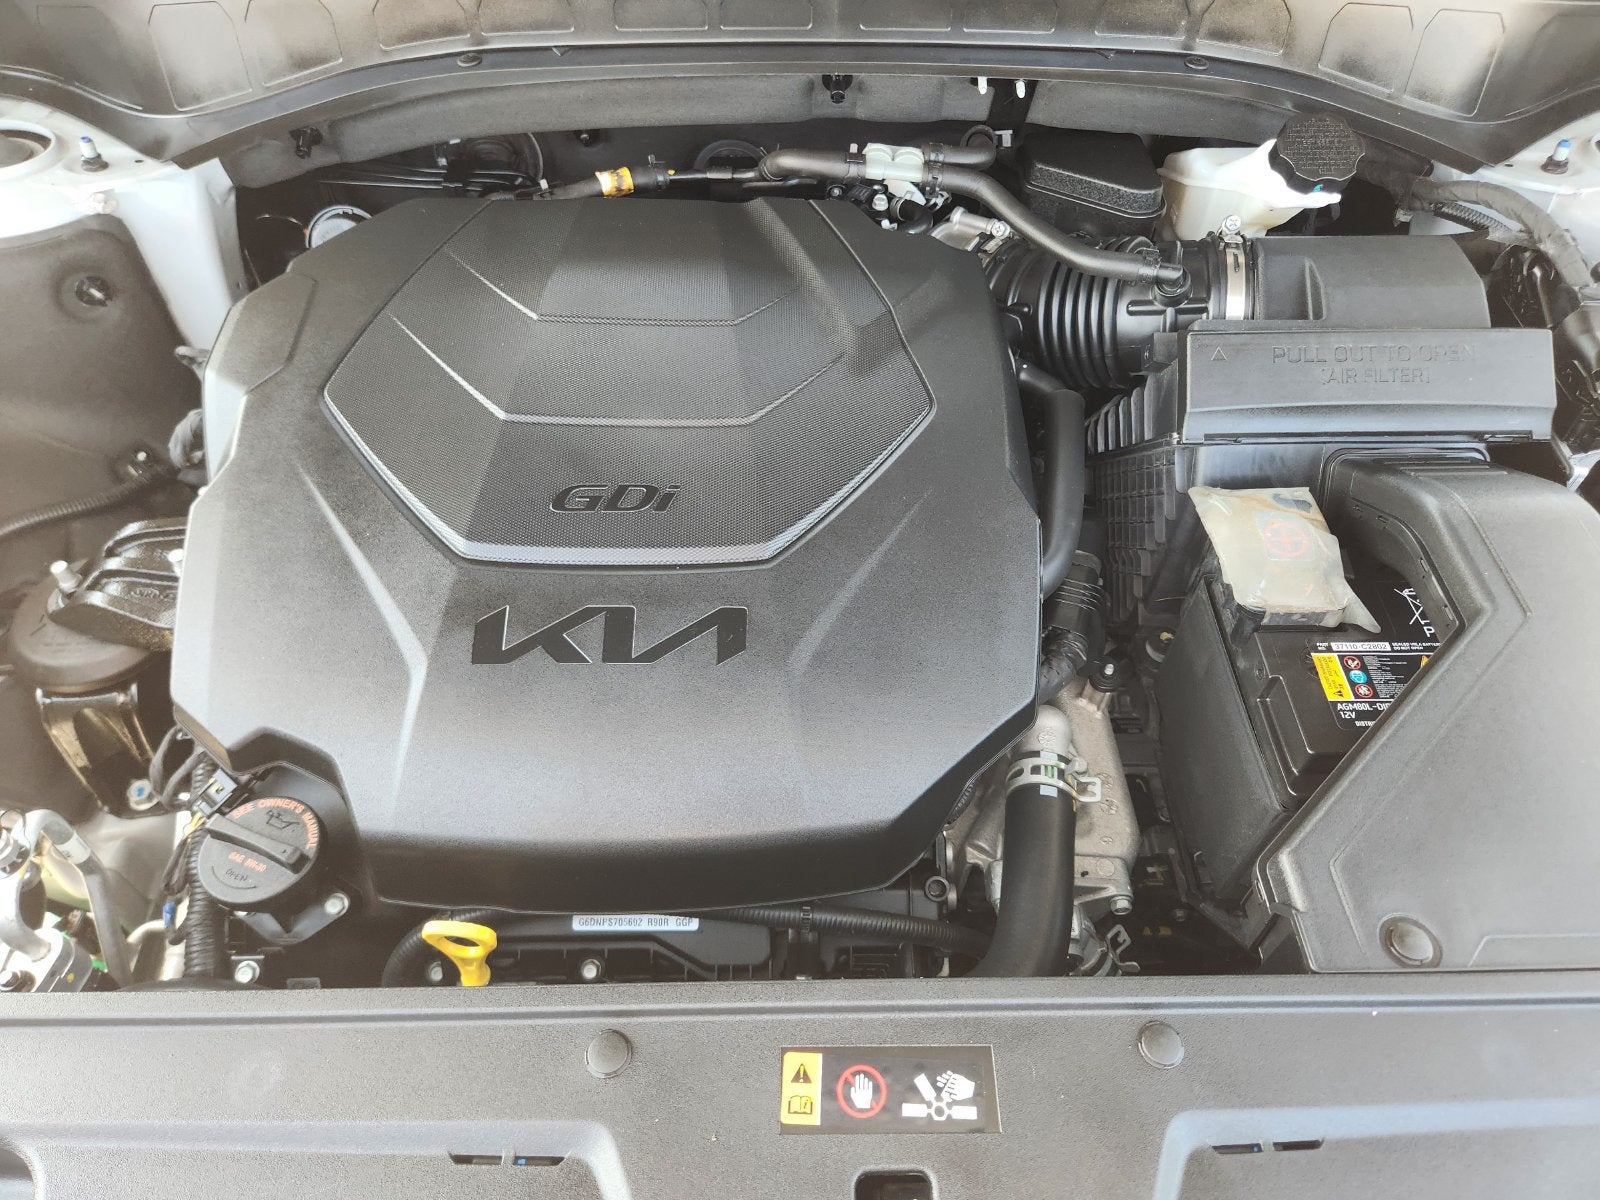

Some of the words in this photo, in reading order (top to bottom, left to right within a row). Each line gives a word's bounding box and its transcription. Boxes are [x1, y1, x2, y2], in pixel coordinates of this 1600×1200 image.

[1272, 346, 1327, 363] PULL
[1334, 345, 1377, 362] OUT
[1385, 345, 1411, 361] TO
[1419, 345, 1476, 361] OPEN
[550, 484, 682, 512] GDi
[471, 604, 748, 665] KIA
[1340, 711, 1356, 719] 12V
[231, 803, 255, 819] SEE
[257, 798, 305, 814] OWNER'S
[302, 811, 319, 850] MANUAL
[229, 851, 245, 864] SAE
[225, 868, 248, 881] OPEN
